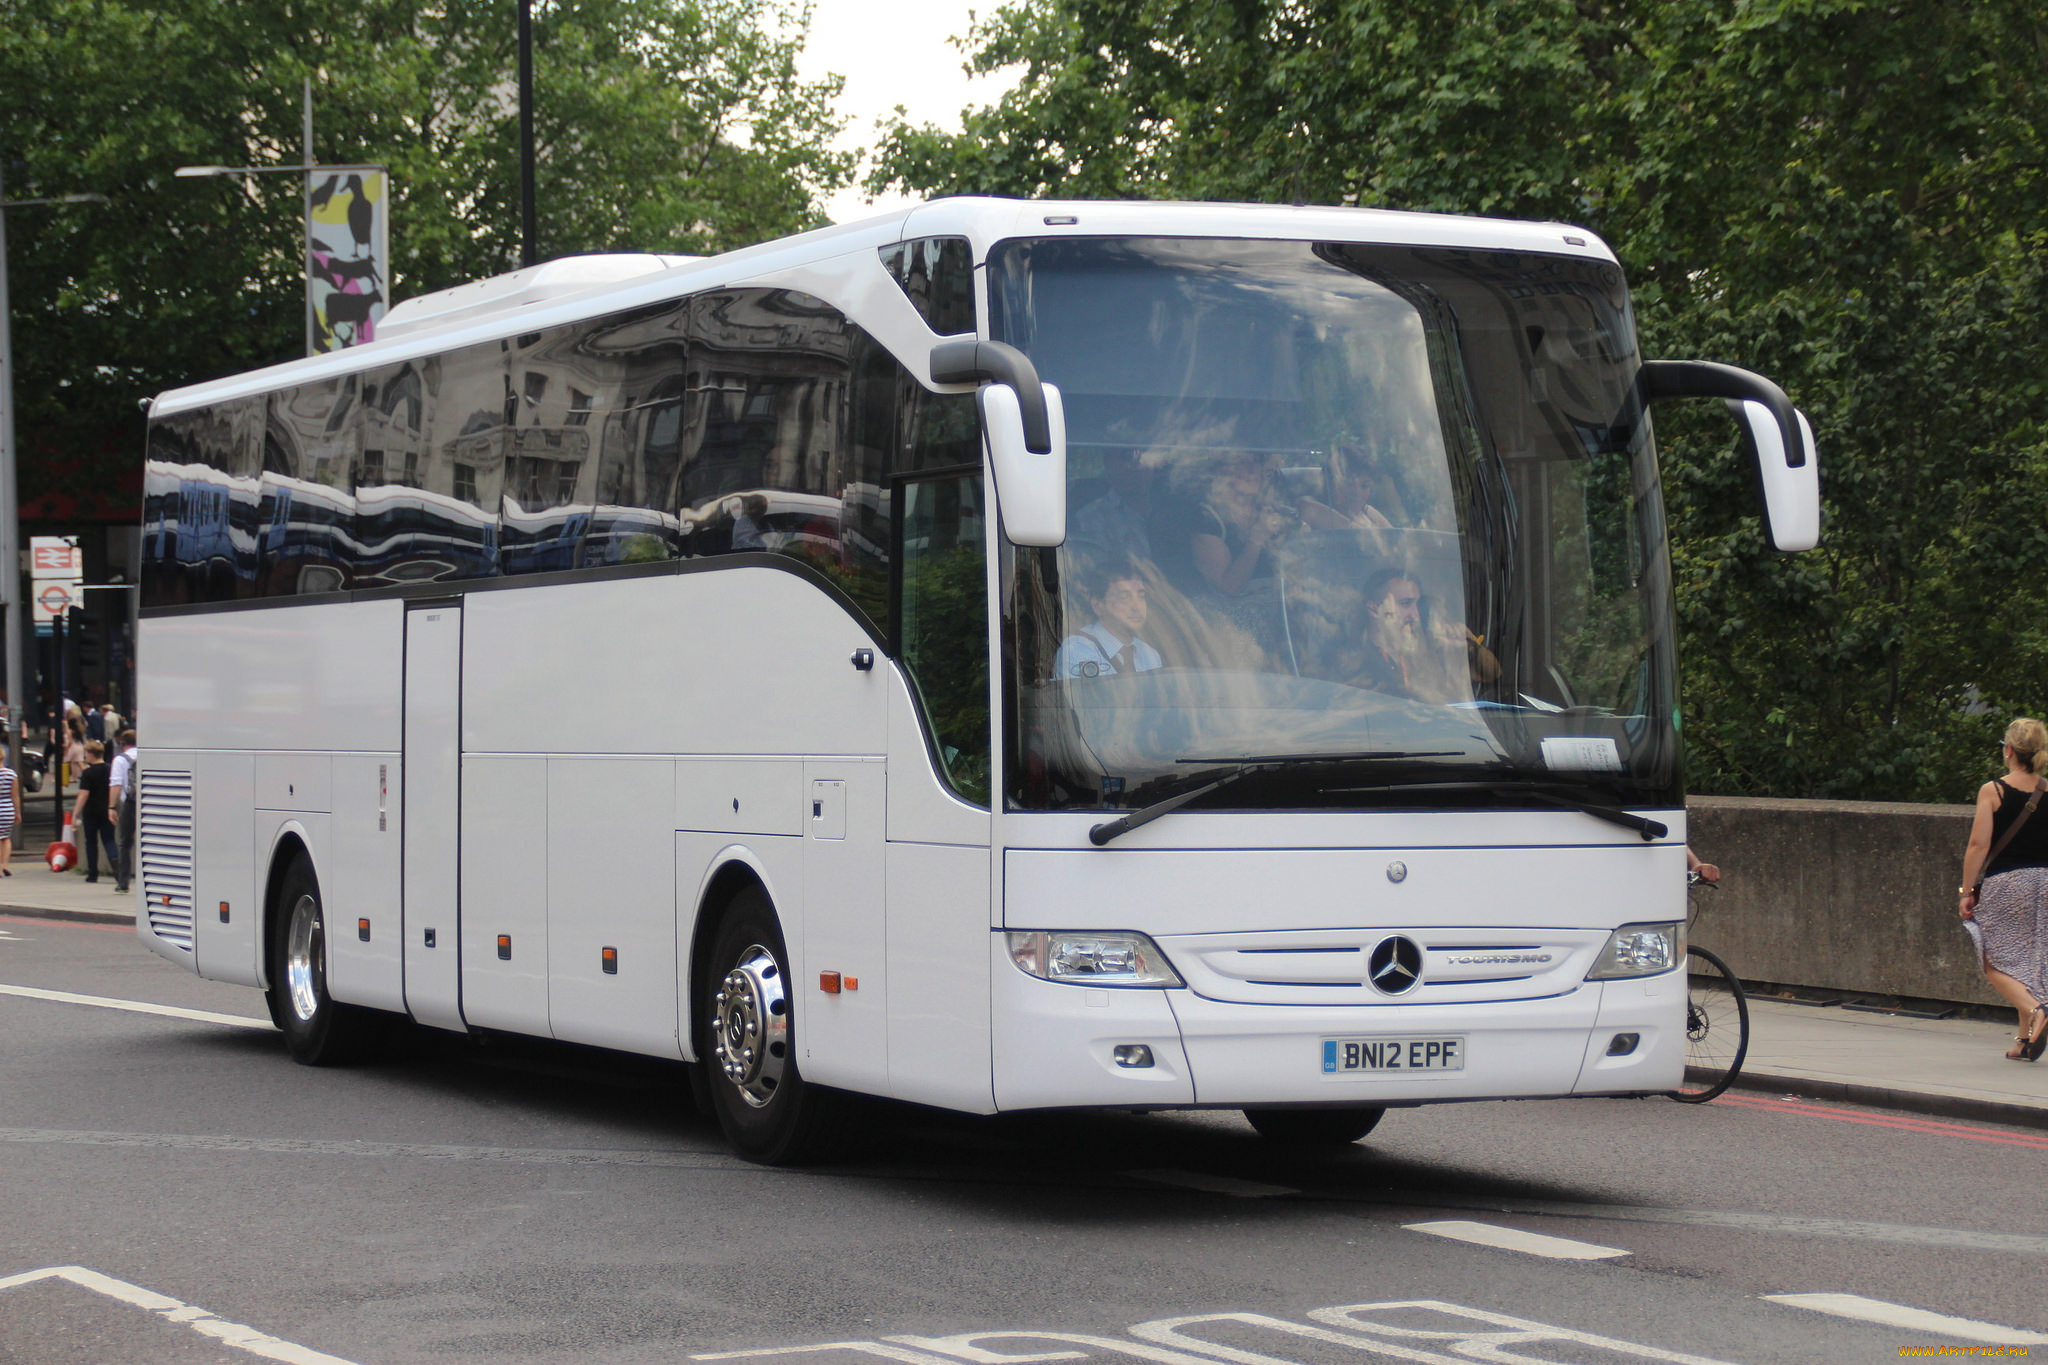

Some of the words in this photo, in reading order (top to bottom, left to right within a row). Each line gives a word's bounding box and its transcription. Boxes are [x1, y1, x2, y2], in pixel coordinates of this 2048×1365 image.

[1447, 954, 1552, 964] TOURISMO
[1345, 1043, 1401, 1069] BN12
[1409, 1042, 1457, 1067] EPF
